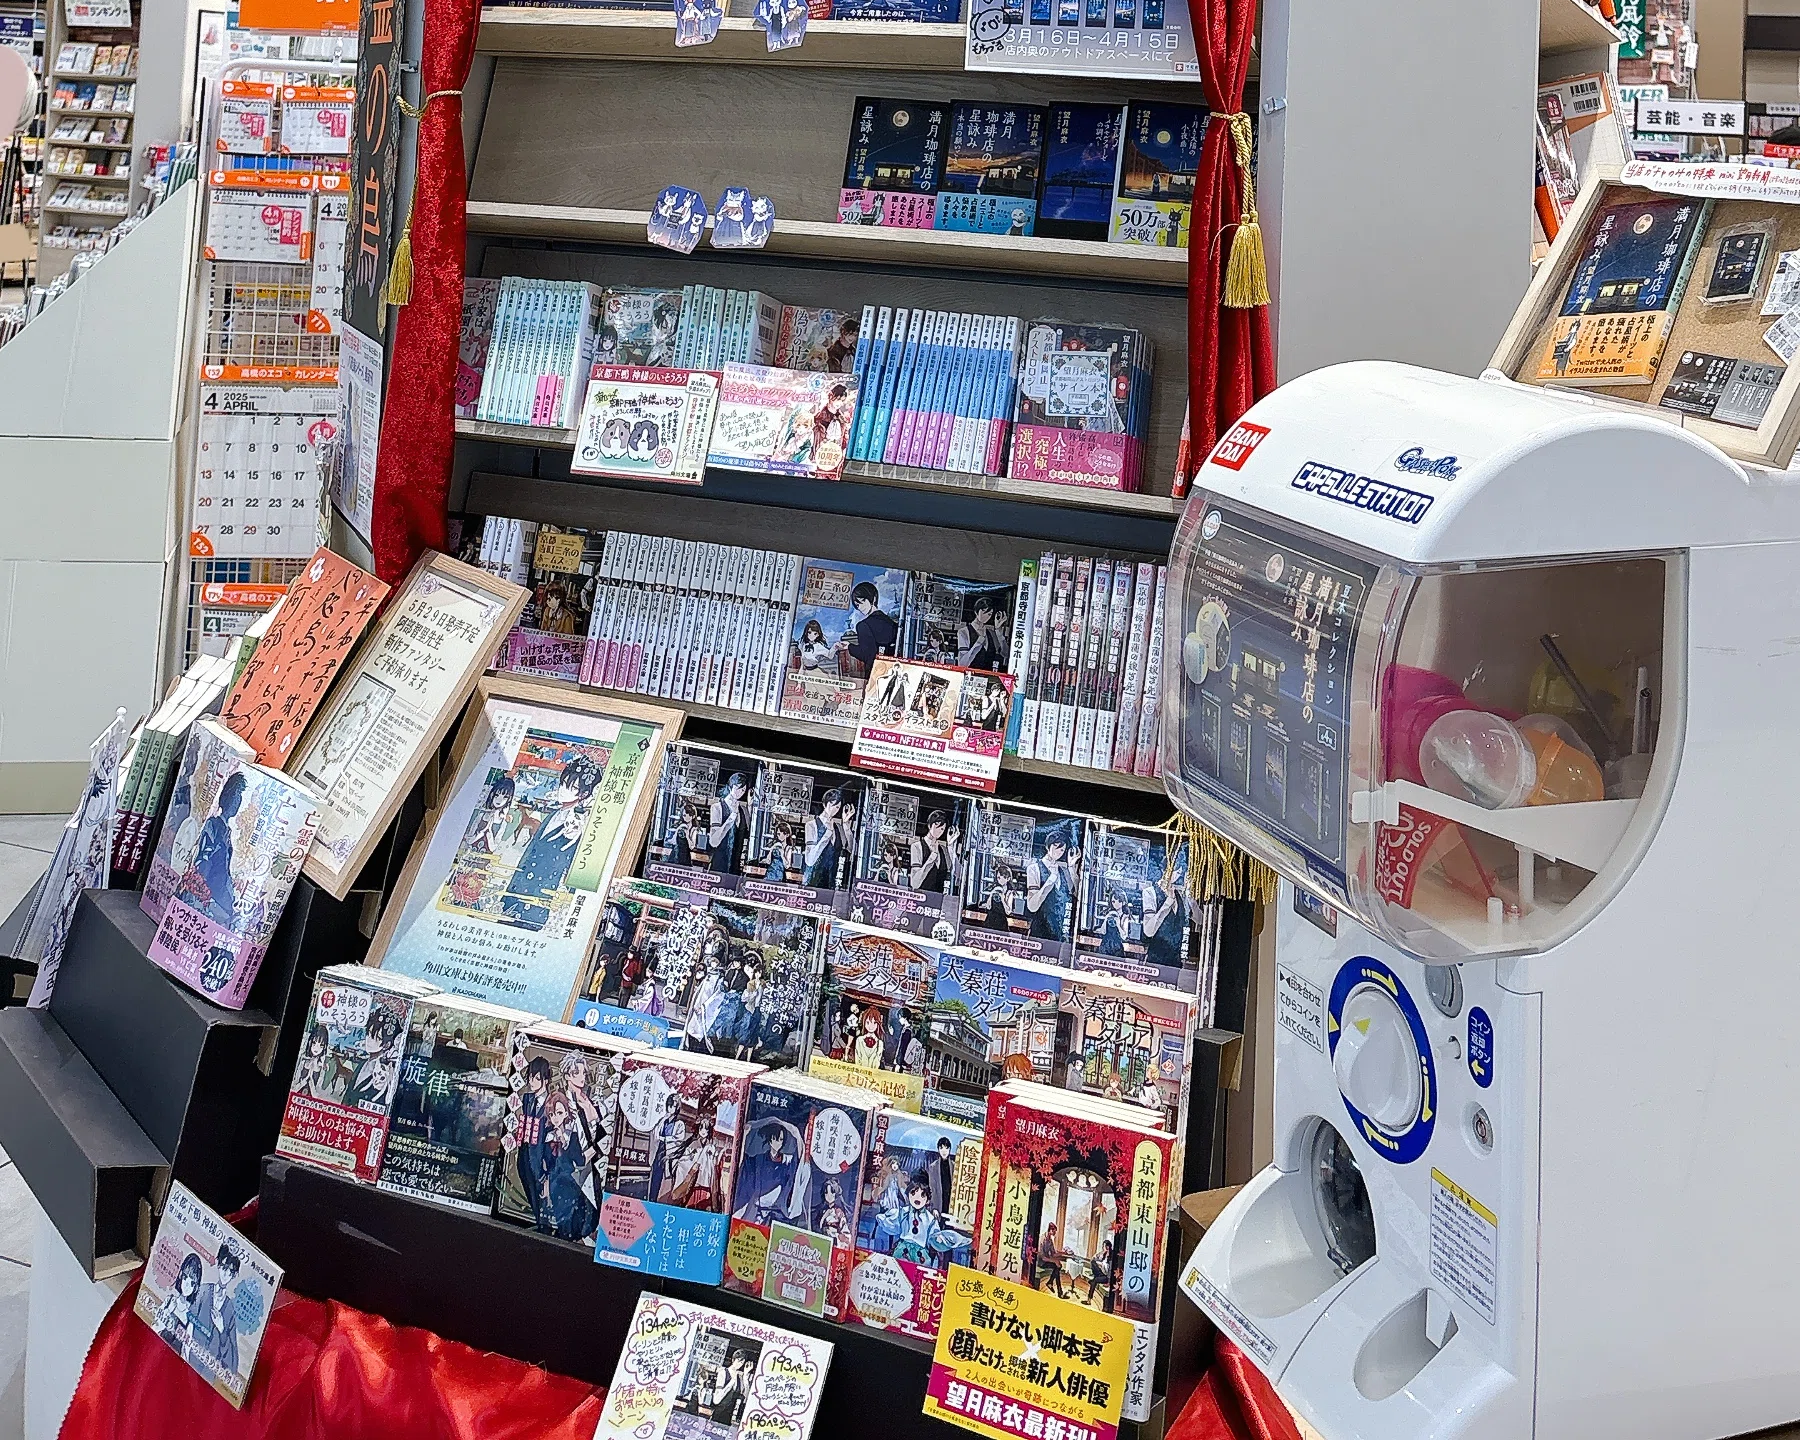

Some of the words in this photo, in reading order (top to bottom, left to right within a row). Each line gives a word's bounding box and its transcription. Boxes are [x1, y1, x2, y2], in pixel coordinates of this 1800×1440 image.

[1005, 44, 1174, 62] 店内奥のアウトドアスペースにて
[859, 106, 874, 145] 星詠み
[967, 109, 981, 149] 星詠み
[1001, 111, 1017, 139] 満月
[1029, 113, 1041, 146] 望月麻衣
[1139, 109, 1151, 144] 望月麻衣
[1646, 110, 1736, 128] 芸能・音楽
[920, 110, 942, 190] 満月珈琲店の
[981, 110, 999, 162] 珈琲店の
[321, 202, 333, 217] 4
[1589, 214, 1616, 262] 星詠み
[317, 263, 328, 273] 13
[1645, 206, 1691, 307] 満月珈琲店の
[315, 286, 327, 295] 20
[475, 283, 490, 328] わが家は
[1027, 331, 1041, 394] アストロロジー
[1121, 335, 1131, 368] 望月麻衣
[594, 369, 630, 381] 京都下鴨
[632, 371, 688, 386] 神様のいそうろう
[205, 393, 218, 409] 4
[223, 401, 258, 411] APRIL
[224, 393, 248, 402] 2025
[250, 416, 255, 425] 1
[274, 417, 280, 425] 2
[297, 417, 303, 426] 3
[1230, 425, 1265, 450] BAN
[202, 442, 209, 452] 6
[225, 443, 232, 452] 7
[248, 443, 255, 452] 8
[272, 444, 278, 453] 9
[296, 444, 307, 453] 10
[1216, 443, 1246, 463] DAI
[201, 470, 212, 479] 13
[224, 471, 235, 480] 14
[247, 471, 259, 480] 15
[271, 471, 282, 480] 16
[294, 472, 305, 481] 17
[199, 498, 212, 507] 20
[221, 498, 234, 507] 21
[245, 498, 259, 507] 22
[269, 499, 282, 508] 23
[292, 499, 305, 508] 24
[221, 525, 234, 535] 28
[244, 525, 257, 535] 29
[267, 526, 280, 535] 30
[541, 535, 557, 544] 京都
[539, 544, 579, 557] 寺町三条の
[805, 579, 850, 595] 寺町三条の
[807, 567, 826, 581] 京都
[408, 599, 481, 646] 5月29日発売予定
[1291, 572, 1317, 643] 星詠み
[397, 616, 444, 652] 阿部智里先生
[1302, 575, 1333, 724] 満月珈琲店の
[1325, 584, 1354, 705] 豆本コレクション
[384, 633, 447, 674] 新作ファンタジー
[373, 656, 430, 696] ご予約承ります。
[1046, 667, 1061, 684] 10
[612, 752, 638, 805] 京都下鴨
[577, 764, 624, 871] 神様のいそうろう
[282, 810, 320, 885] 亡霊の烏
[1408, 822, 1431, 858] SOLD
[1390, 859, 1410, 901] OUT
[171, 903, 209, 935] いつかきっと
[260, 888, 287, 944] 阿部智里
[563, 894, 585, 940] 望月麻衣
[1062, 902, 1073, 934] 望月麻衣
[1180, 926, 1190, 959] 望月麻衣
[940, 958, 1007, 997] 太秦荘
[319, 1008, 367, 1023] いそうろう
[336, 994, 368, 1009] 神様の
[972, 998, 1055, 1031] ダイアリー
[1063, 984, 1131, 1021] 太秦荘
[1278, 992, 1322, 1028] てからコインを
[1278, 1011, 1323, 1052] 入れてください。
[1470, 1016, 1490, 1035] コイン
[1470, 1031, 1490, 1050] 返却
[1470, 1045, 1491, 1064] ボタン
[403, 1056, 450, 1097] 旋律
[627, 1079, 639, 1114] 嫁ぎ先
[656, 1091, 666, 1113] 京都
[755, 1092, 789, 1108] 望月麻衣
[288, 1104, 370, 1140] 神様と人のお悩み、
[295, 1123, 356, 1152] お助けします。
[812, 1119, 825, 1154] 嫁ぎ先
[1014, 1118, 1060, 1142] 望月麻衣
[615, 1146, 646, 1163] 望月麻衣
[842, 1132, 853, 1158] 京都
[872, 1116, 889, 1167] 望月麻衣
[383, 1153, 441, 1177] この気持ちは
[956, 1145, 981, 1225] 陰陽師!?
[692, 1223, 706, 1249] 恋の
[707, 1218, 722, 1258] 許嫁の
[1001, 1179, 1027, 1284] 小鳥遊先
[1126, 1154, 1157, 1294] 京都東山邸の
[658, 1210, 678, 1272] わたしでは
[674, 1228, 691, 1270] 相手は
[778, 1238, 822, 1263] 望月麻衣
[771, 1264, 823, 1291] サイン本
[958, 1279, 985, 1295] 35歳
[992, 1286, 1017, 1304] 独身
[917, 1279, 934, 1323] 陰陽師
[970, 1302, 1104, 1367] 書けない脚本家
[950, 1328, 1002, 1368] 顔だけ
[1027, 1358, 1111, 1409] 新人俳優
[1129, 1328, 1149, 1407] エンタメ作家
[965, 1368, 1085, 1419] 2人の出会いが奇跡につながる
